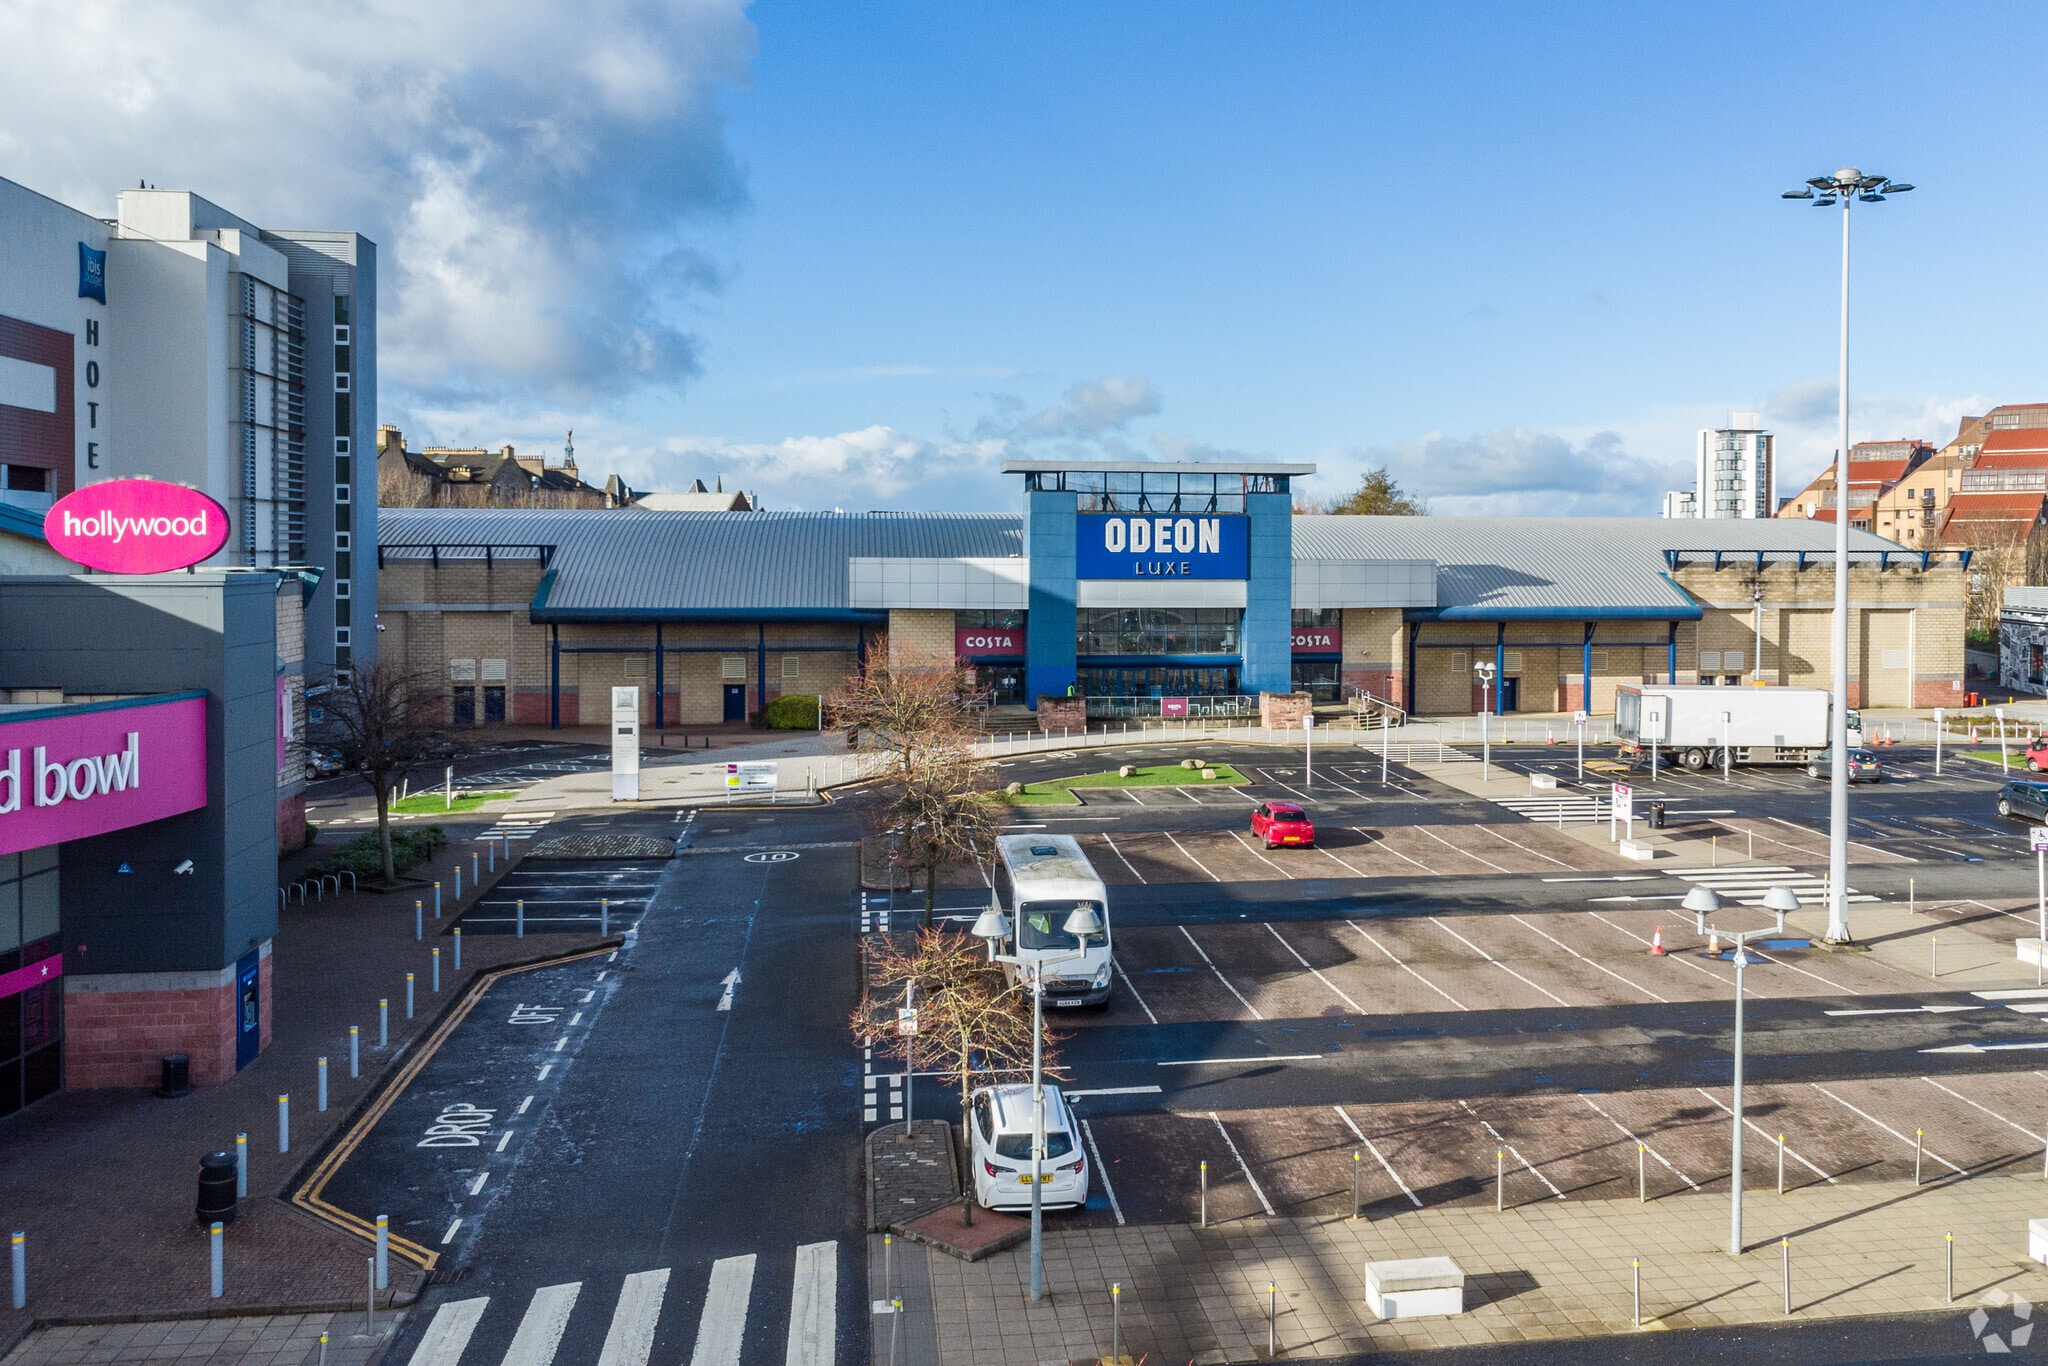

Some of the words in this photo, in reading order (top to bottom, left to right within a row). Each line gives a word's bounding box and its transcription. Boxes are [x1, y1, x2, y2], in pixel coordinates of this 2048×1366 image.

[87, 256, 101, 275] ibis
[63, 509, 207, 543] hollywood
[1105, 518, 1220, 553] ODEON
[1135, 561, 1192, 575] LUXE
[965, 636, 1012, 649] COSTA
[33, 731, 139, 807] bowl
[760, 853, 787, 861] 10
[416, 1102, 498, 1147] DROP
[508, 1003, 564, 1025] OFF
